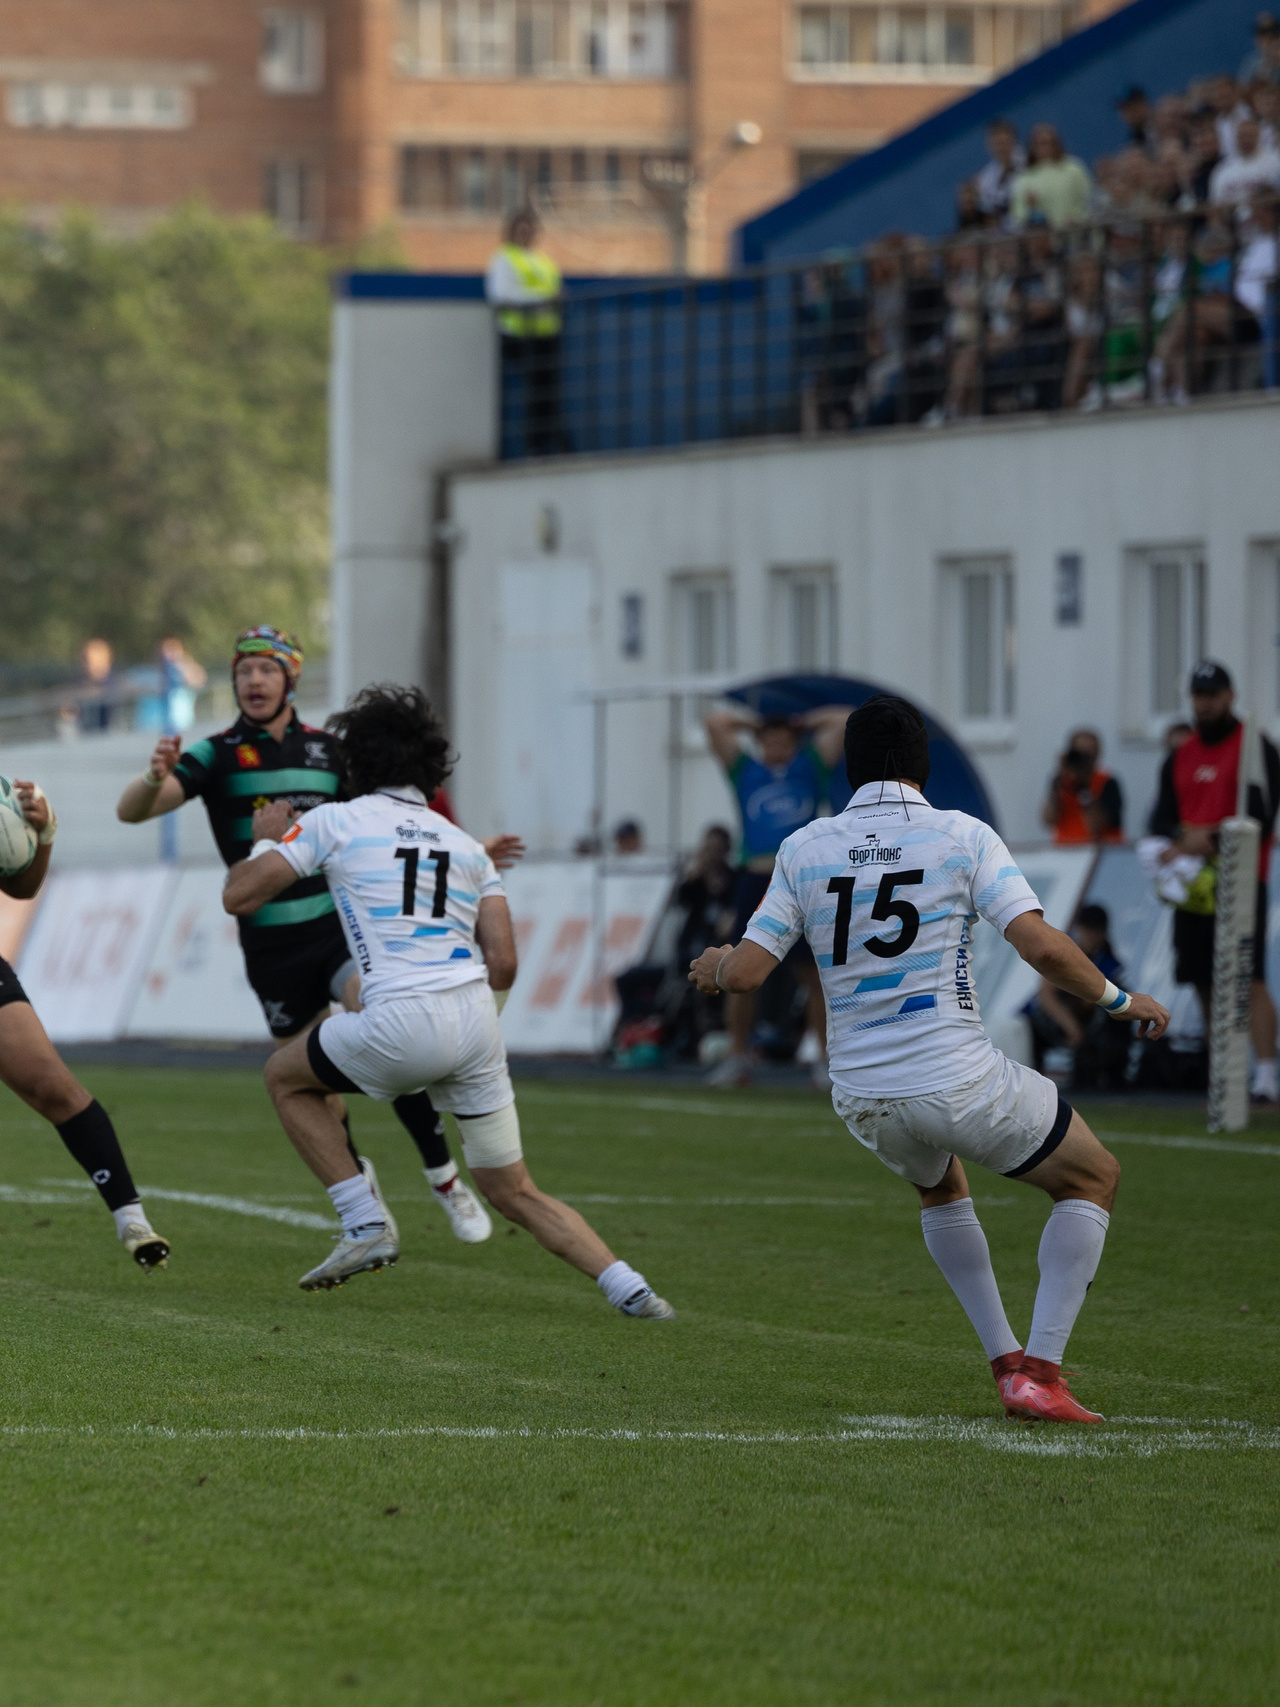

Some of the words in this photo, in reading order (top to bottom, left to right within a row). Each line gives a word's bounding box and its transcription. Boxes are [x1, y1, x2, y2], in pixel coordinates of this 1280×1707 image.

[394, 847, 450, 918] 11
[826, 869, 925, 967] 15
[357, 943, 372, 975] СТМ
